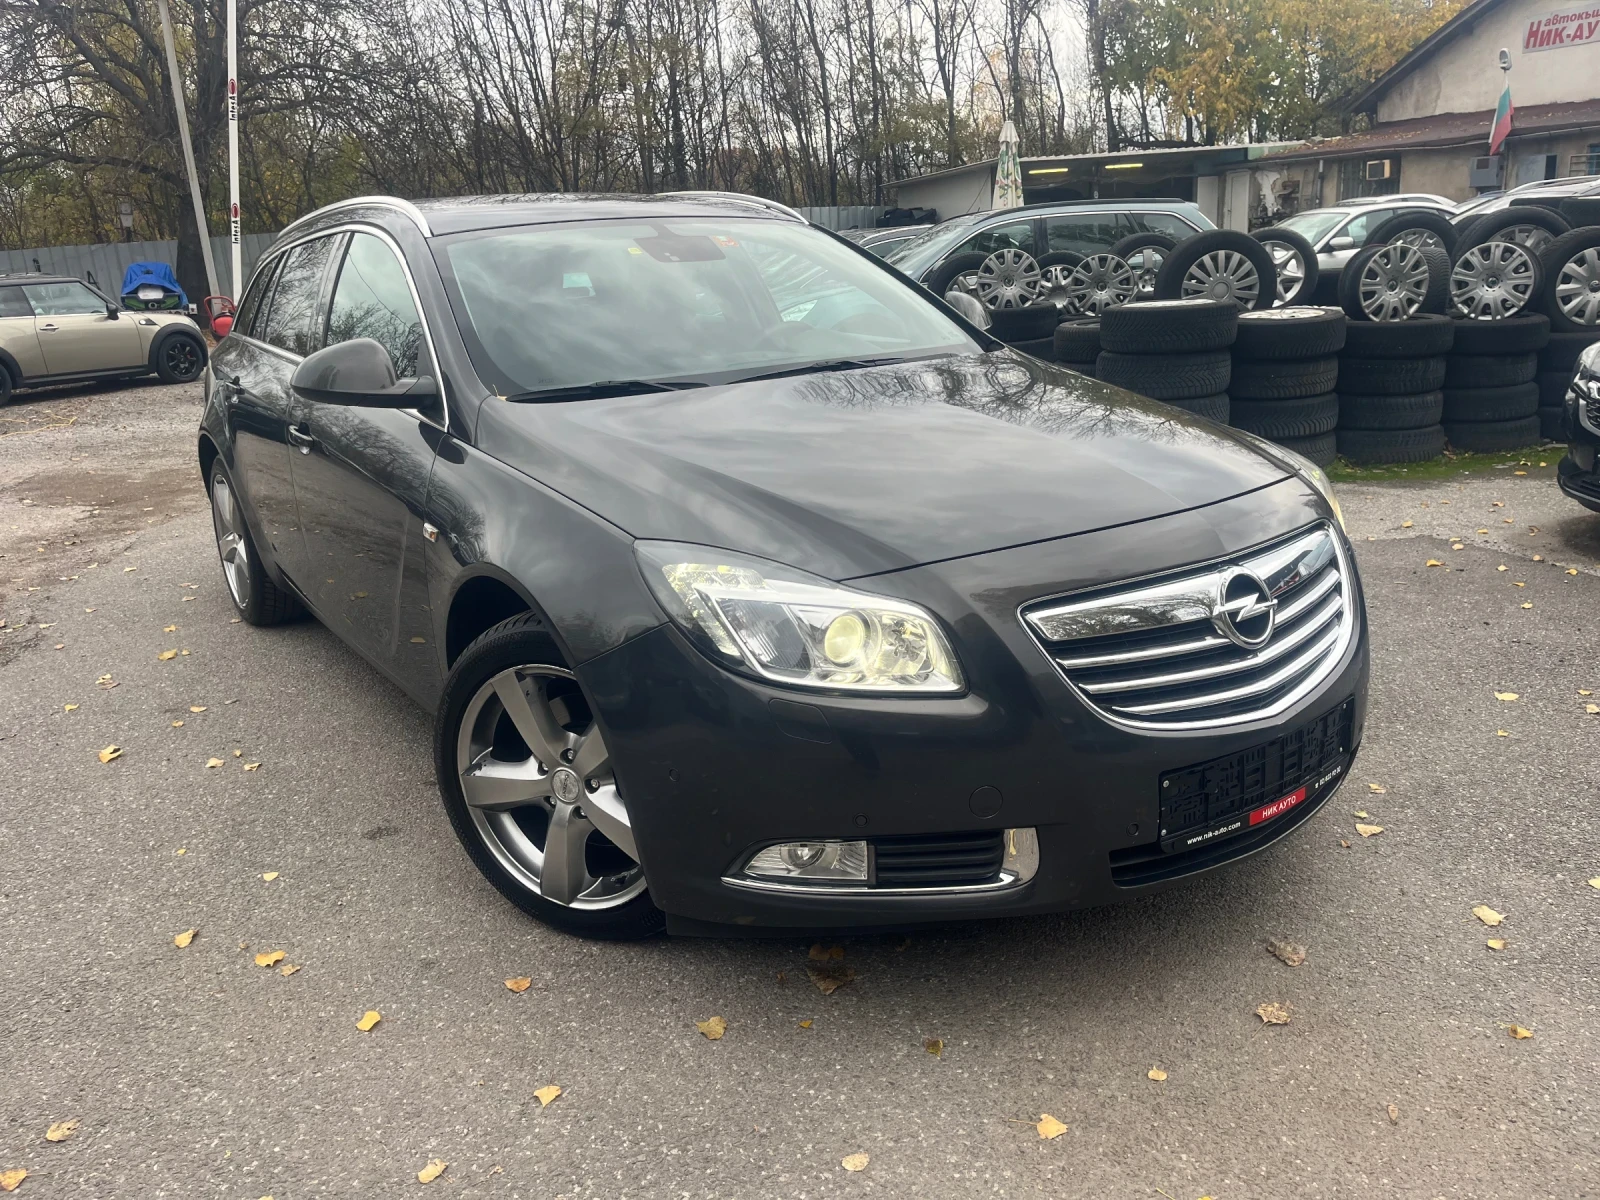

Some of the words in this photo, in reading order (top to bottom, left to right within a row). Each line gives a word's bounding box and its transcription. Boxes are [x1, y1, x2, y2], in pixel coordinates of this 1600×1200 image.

[1262, 804, 1278, 819] НИК
[1278, 795, 1297, 814] АУТО
[1186, 821, 1241, 845] www.nik-auto.com
